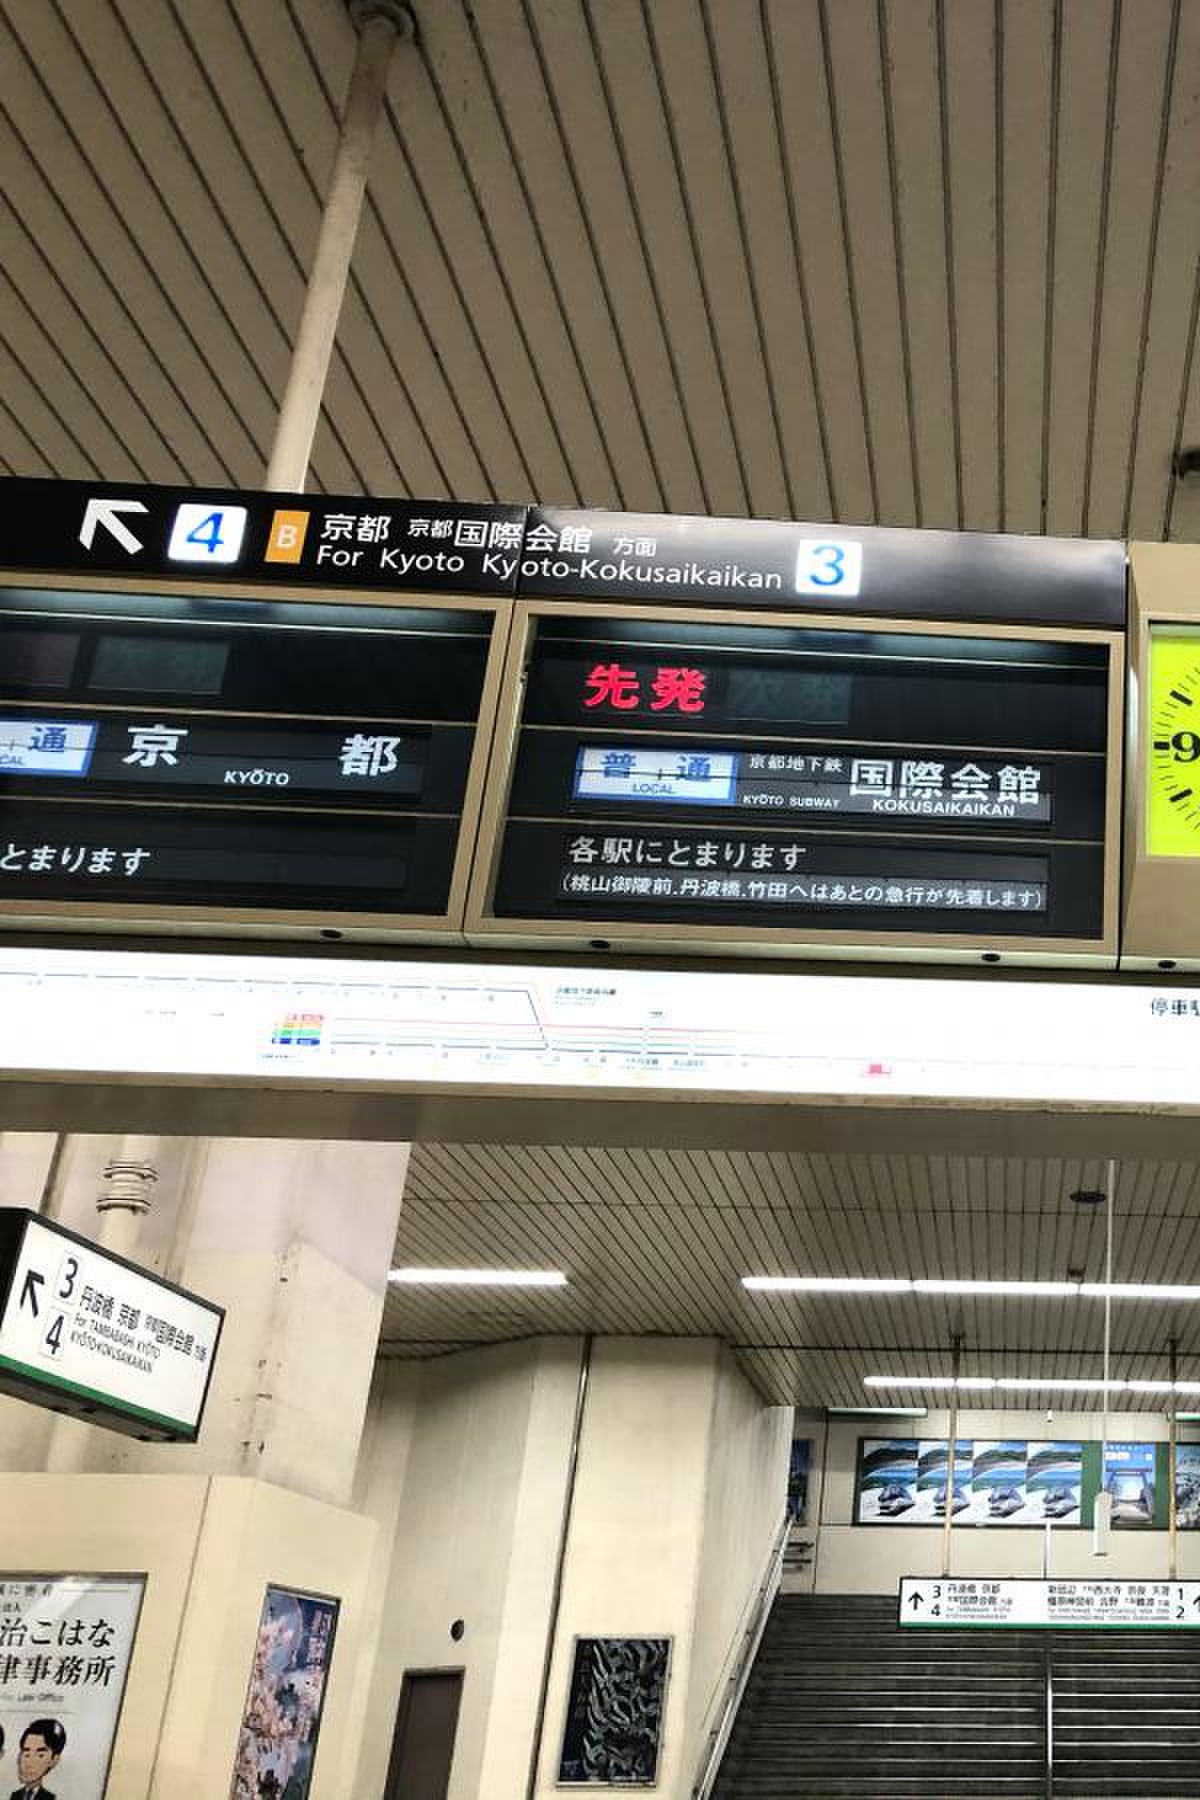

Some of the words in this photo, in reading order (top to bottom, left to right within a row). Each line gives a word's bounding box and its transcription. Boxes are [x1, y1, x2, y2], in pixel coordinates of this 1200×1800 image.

[186, 512, 224, 553] 4
[276, 524, 298, 549] B
[319, 513, 391, 543] 京都
[613, 536, 658, 558] 方面
[316, 545, 363, 567] For
[379, 548, 465, 576] Kyoto
[481, 553, 782, 590] Kyoto-Kokusaikaikan
[808, 542, 846, 587] 3
[584, 662, 706, 713] 先発
[631, 783, 676, 796] LOCAL
[850, 757, 1042, 805] 国際会館
[789, 796, 841, 808] SUBWAY
[872, 799, 1016, 818] KOKUSAIKAIKAN
[0, 843, 151, 878] とまります
[568, 836, 807, 871] 各駅にとまります
[59, 1257, 79, 1299] 3
[45, 1314, 64, 1355] 4
[931, 1604, 941, 1617] 4
[932, 1584, 942, 1599] 3
